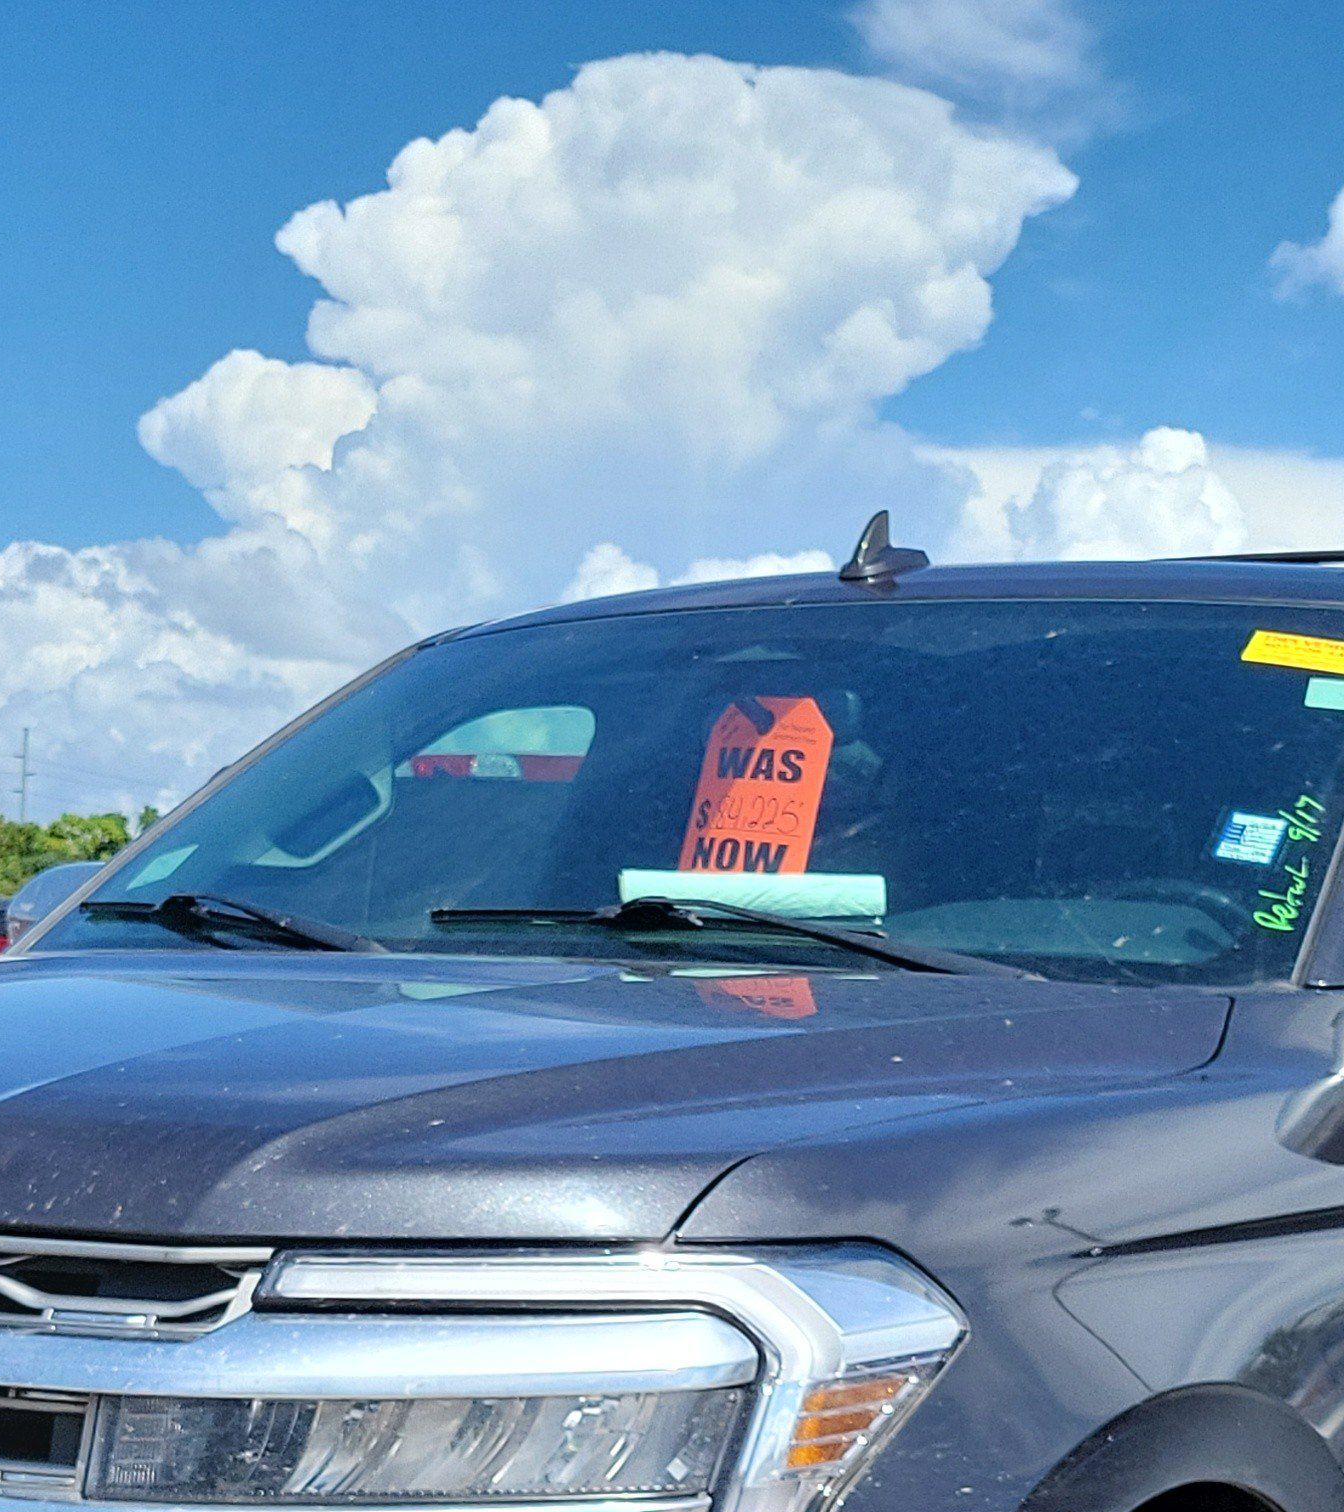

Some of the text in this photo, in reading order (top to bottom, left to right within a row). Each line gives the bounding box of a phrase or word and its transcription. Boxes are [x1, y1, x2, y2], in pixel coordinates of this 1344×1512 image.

[717, 747, 806, 783] WAS
[1278, 794, 1326, 842] 9/17
[691, 836, 789, 873] NOW
